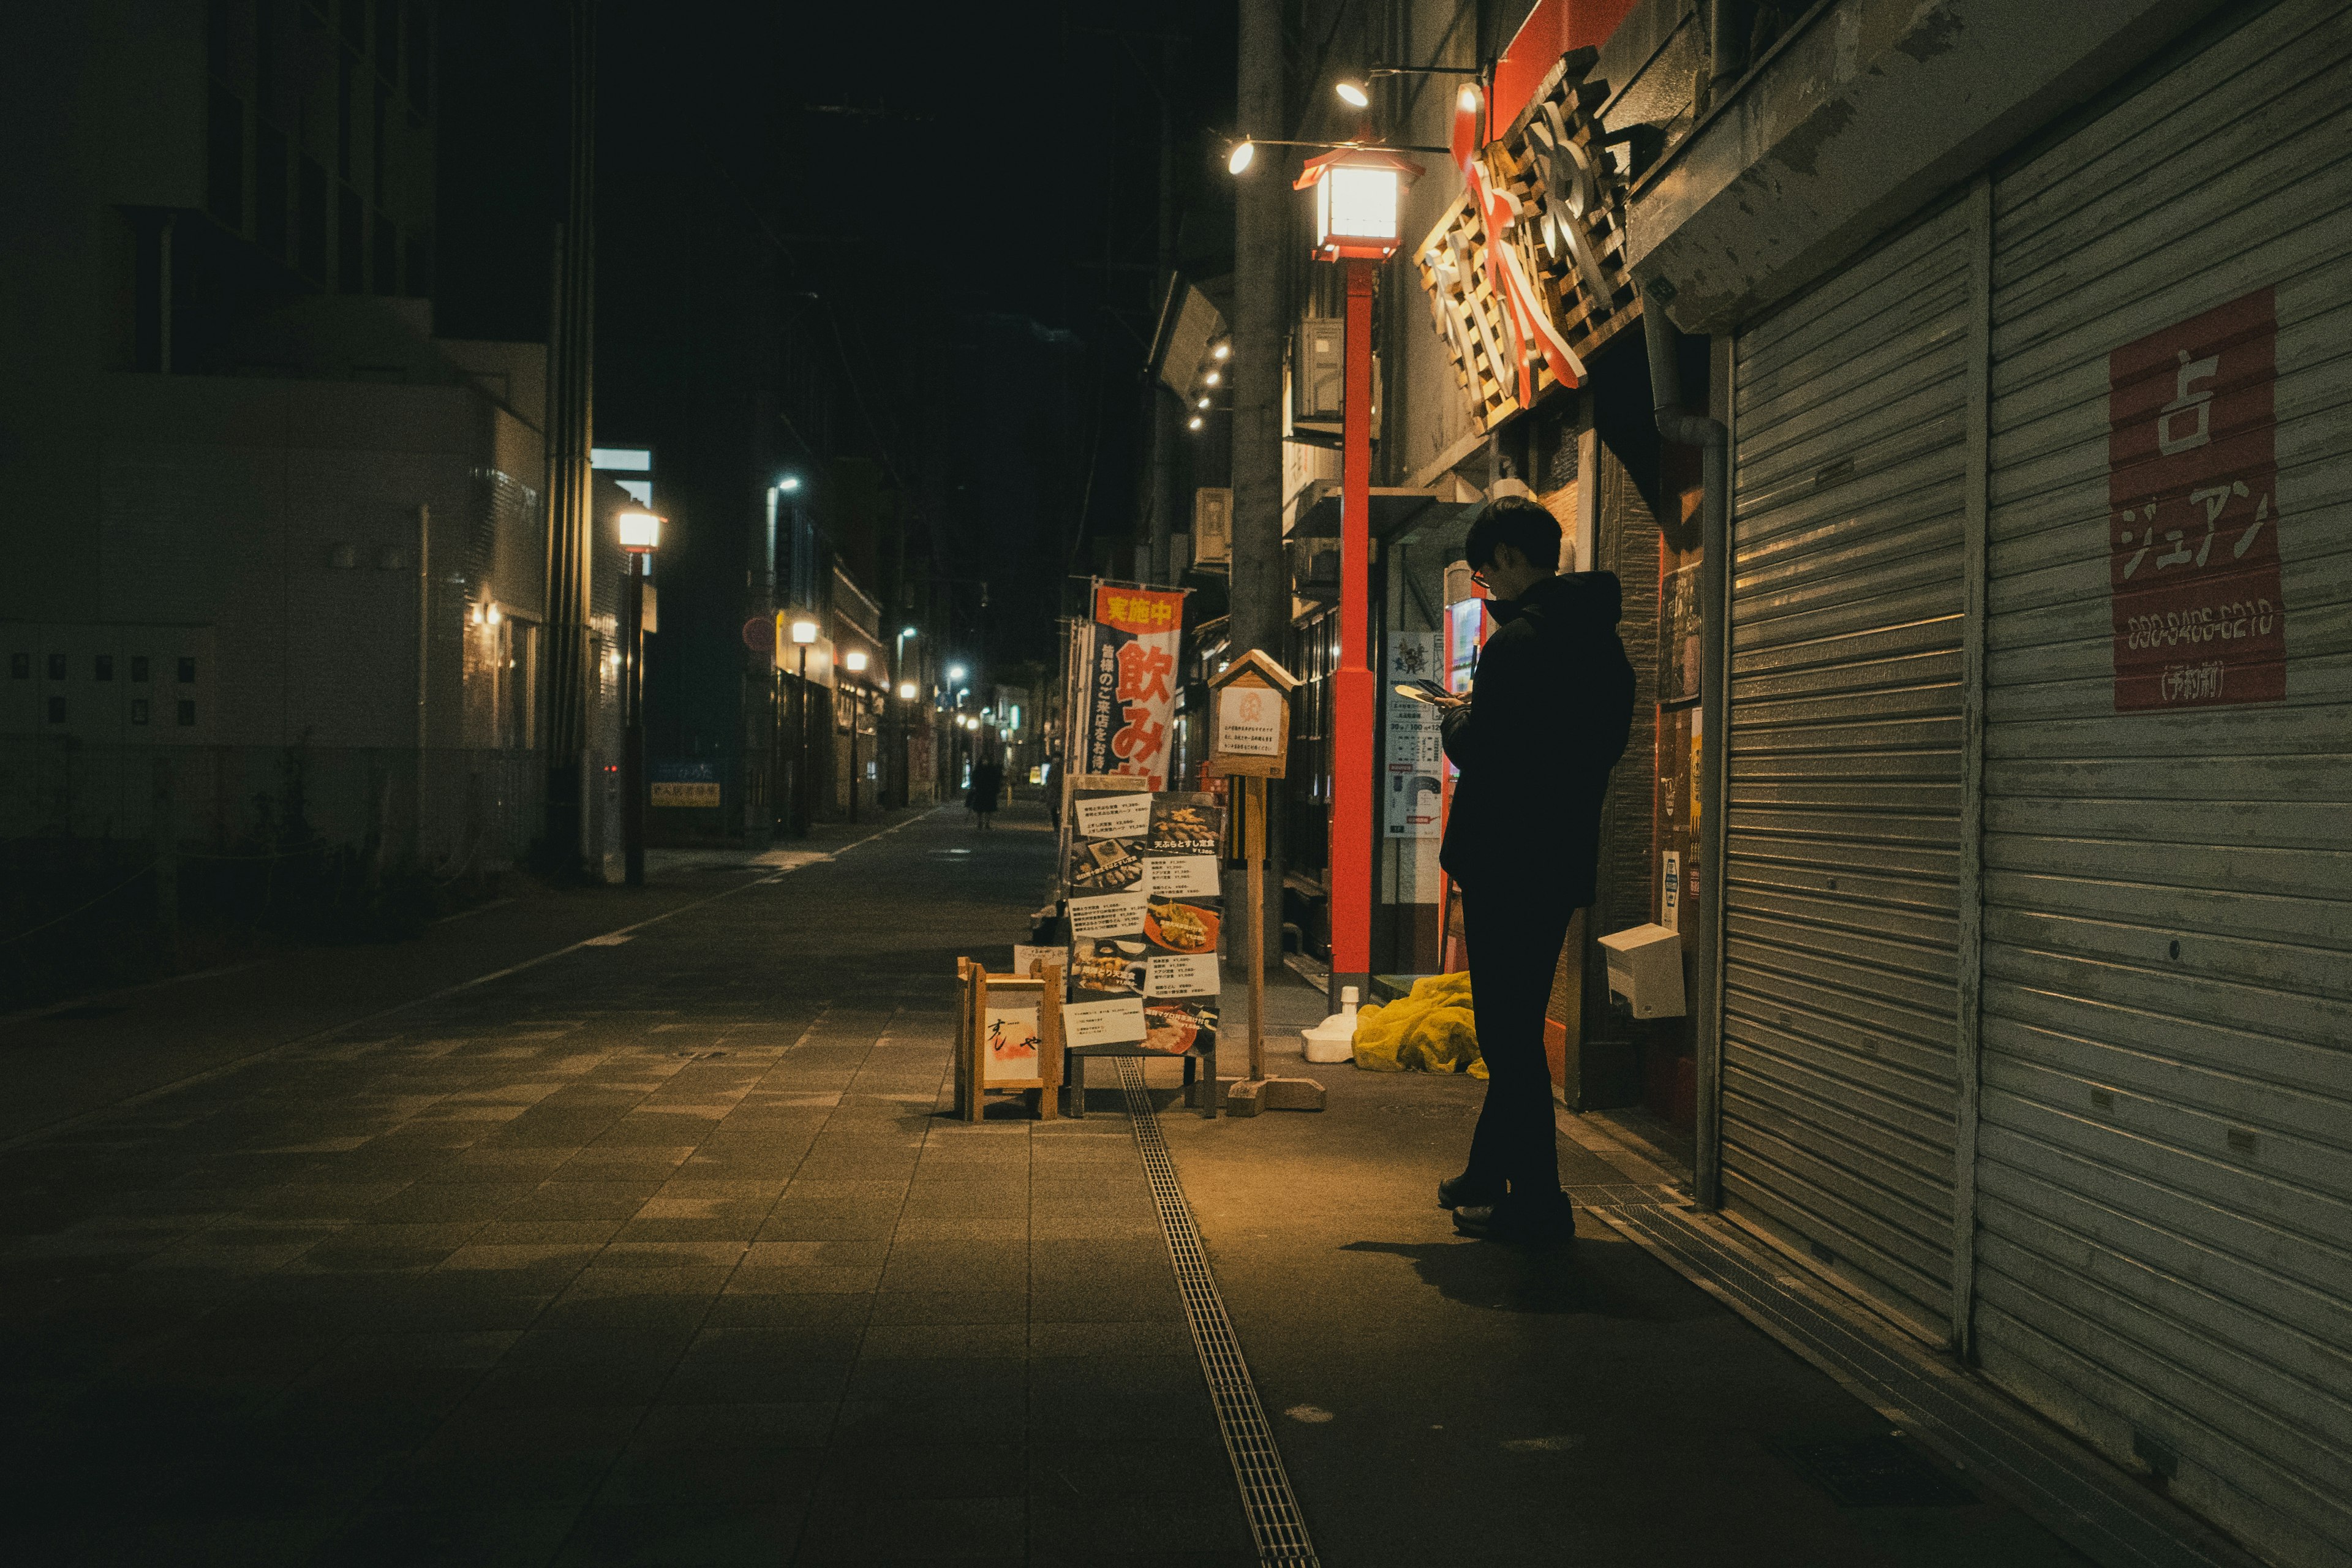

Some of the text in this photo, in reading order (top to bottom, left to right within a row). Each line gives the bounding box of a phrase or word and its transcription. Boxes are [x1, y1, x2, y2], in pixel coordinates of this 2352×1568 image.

[2158, 349, 2220, 456] 占
[1108, 596, 1172, 625] 実施中
[1154, 839, 1215, 848] 天ぷらとすし定食
